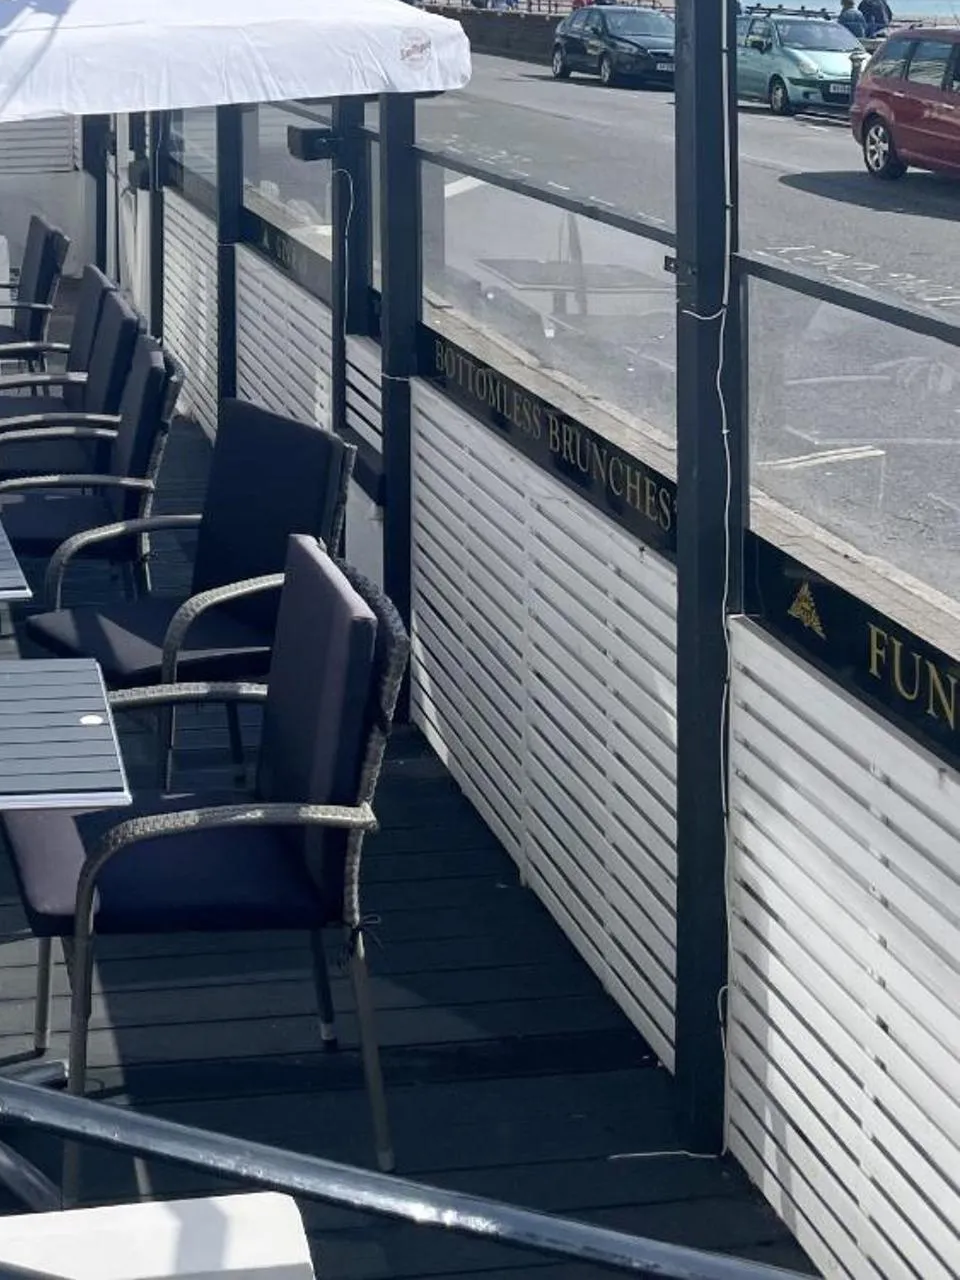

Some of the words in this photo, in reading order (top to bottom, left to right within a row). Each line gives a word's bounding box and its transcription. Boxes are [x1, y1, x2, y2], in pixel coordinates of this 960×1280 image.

[434, 339, 541, 440] BOTTOMLESS
[545, 410, 672, 532] BRUNCHES
[866, 621, 959, 732] FUN
